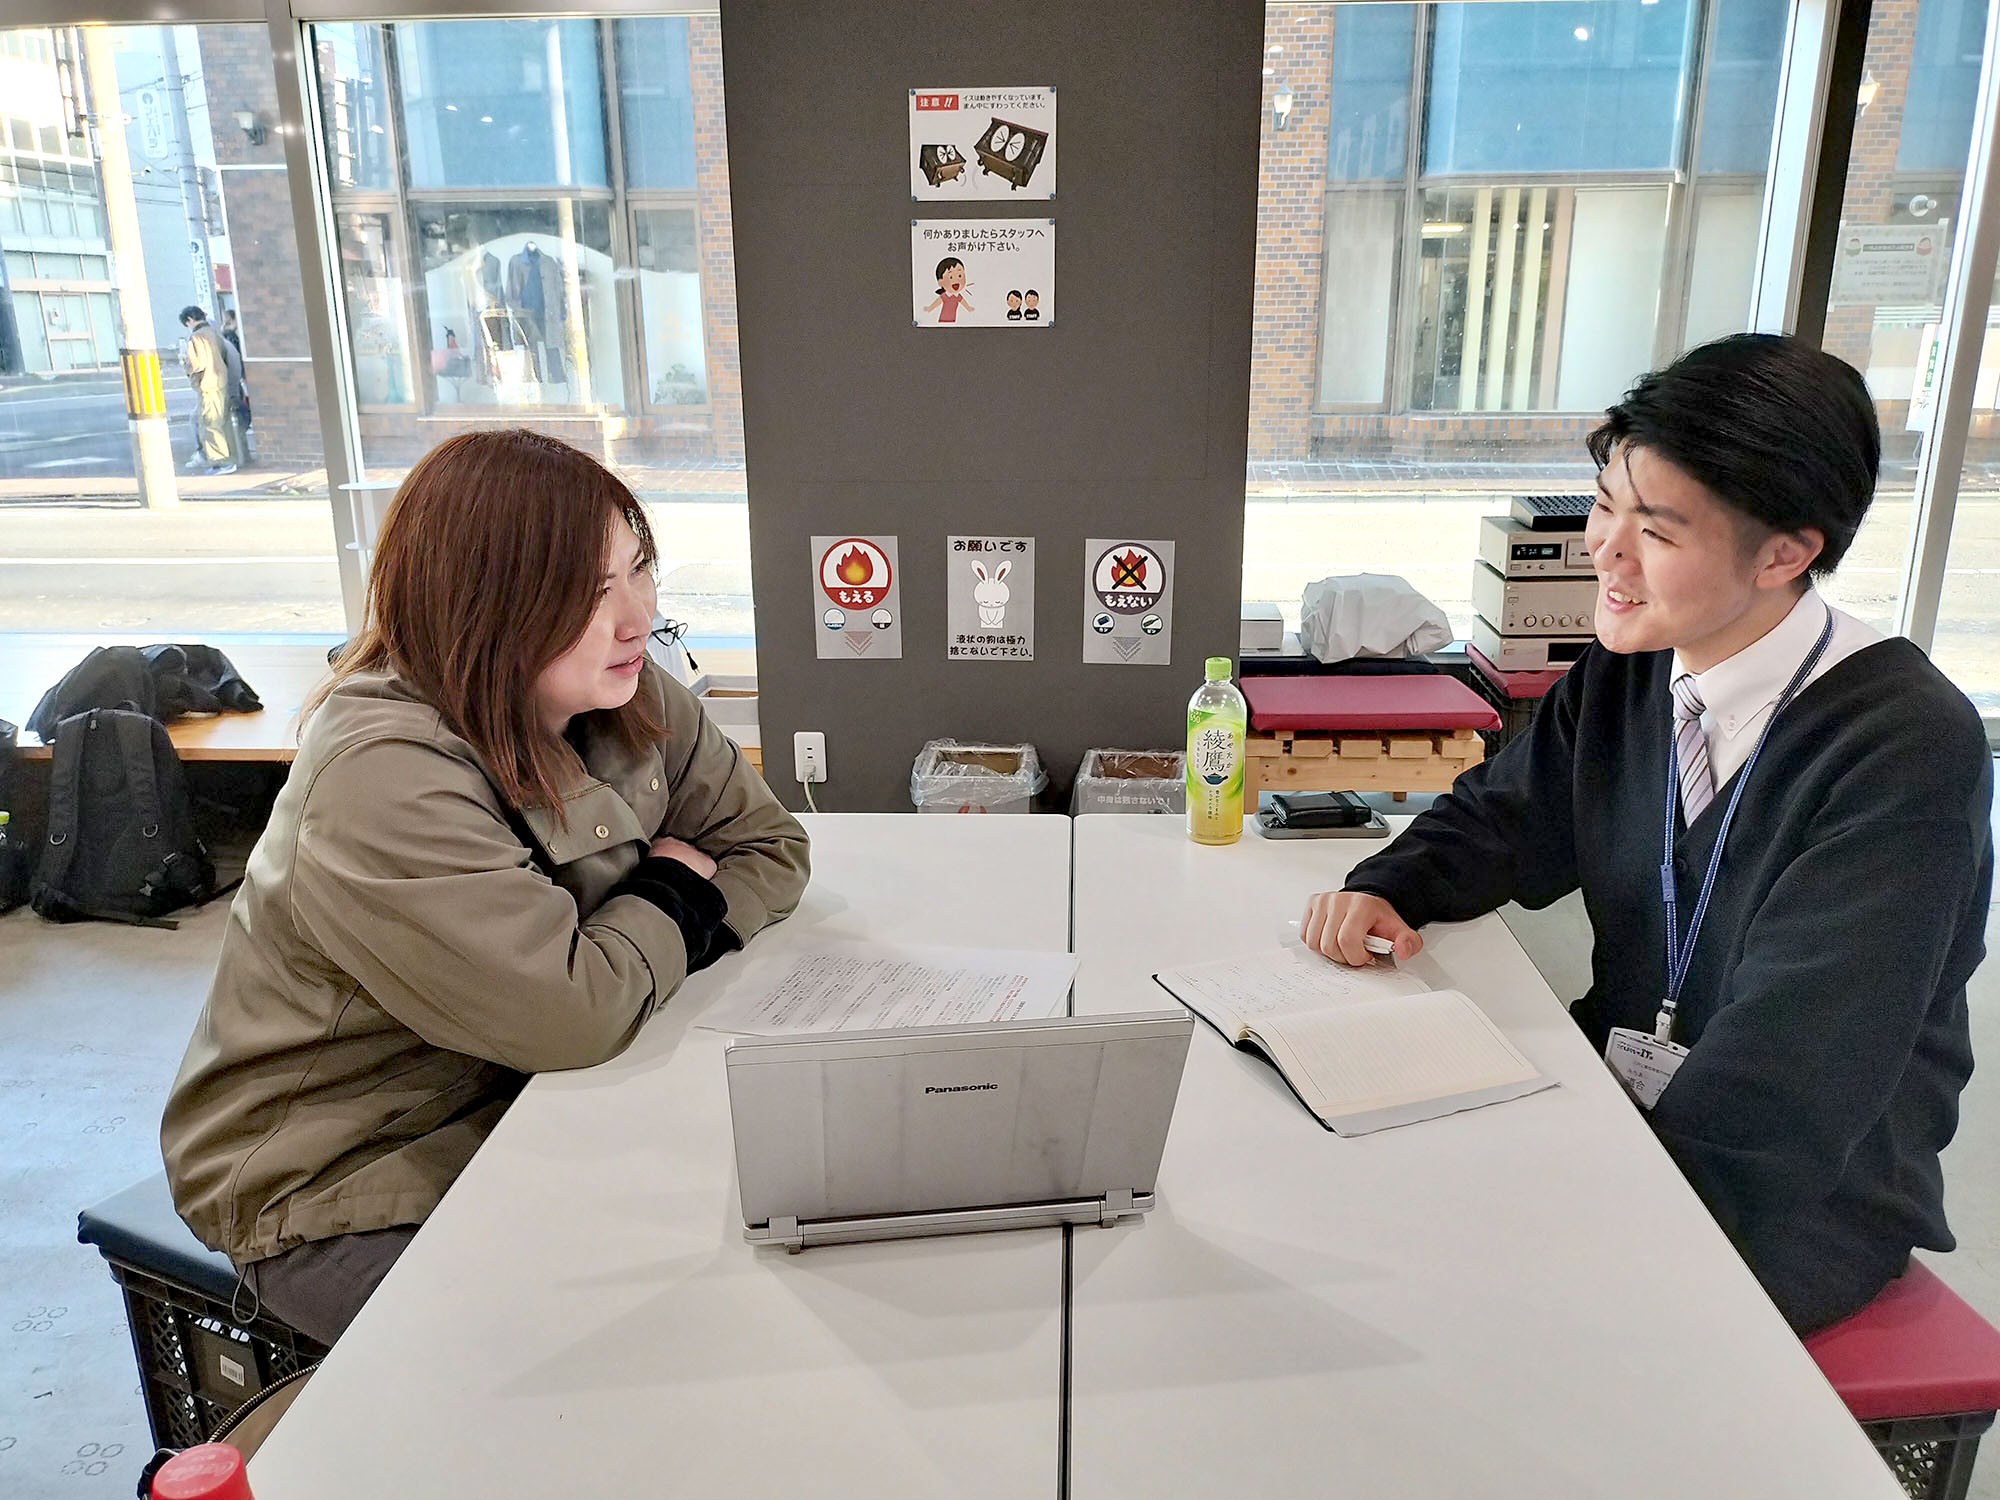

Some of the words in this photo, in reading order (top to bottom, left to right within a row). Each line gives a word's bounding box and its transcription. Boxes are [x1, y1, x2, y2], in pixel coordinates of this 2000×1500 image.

[923, 228, 1045, 240] 何かありましたらスタッフへ
[953, 539, 1028, 553] お願いです
[838, 590, 875, 604] もえる
[1104, 593, 1153, 608] もえない
[955, 634, 1026, 645] 液状の物は極力
[949, 646, 1033, 657] 捨てないで下さい。
[1203, 730, 1226, 772] 綾鷹
[925, 1083, 999, 1095] Panasonic
